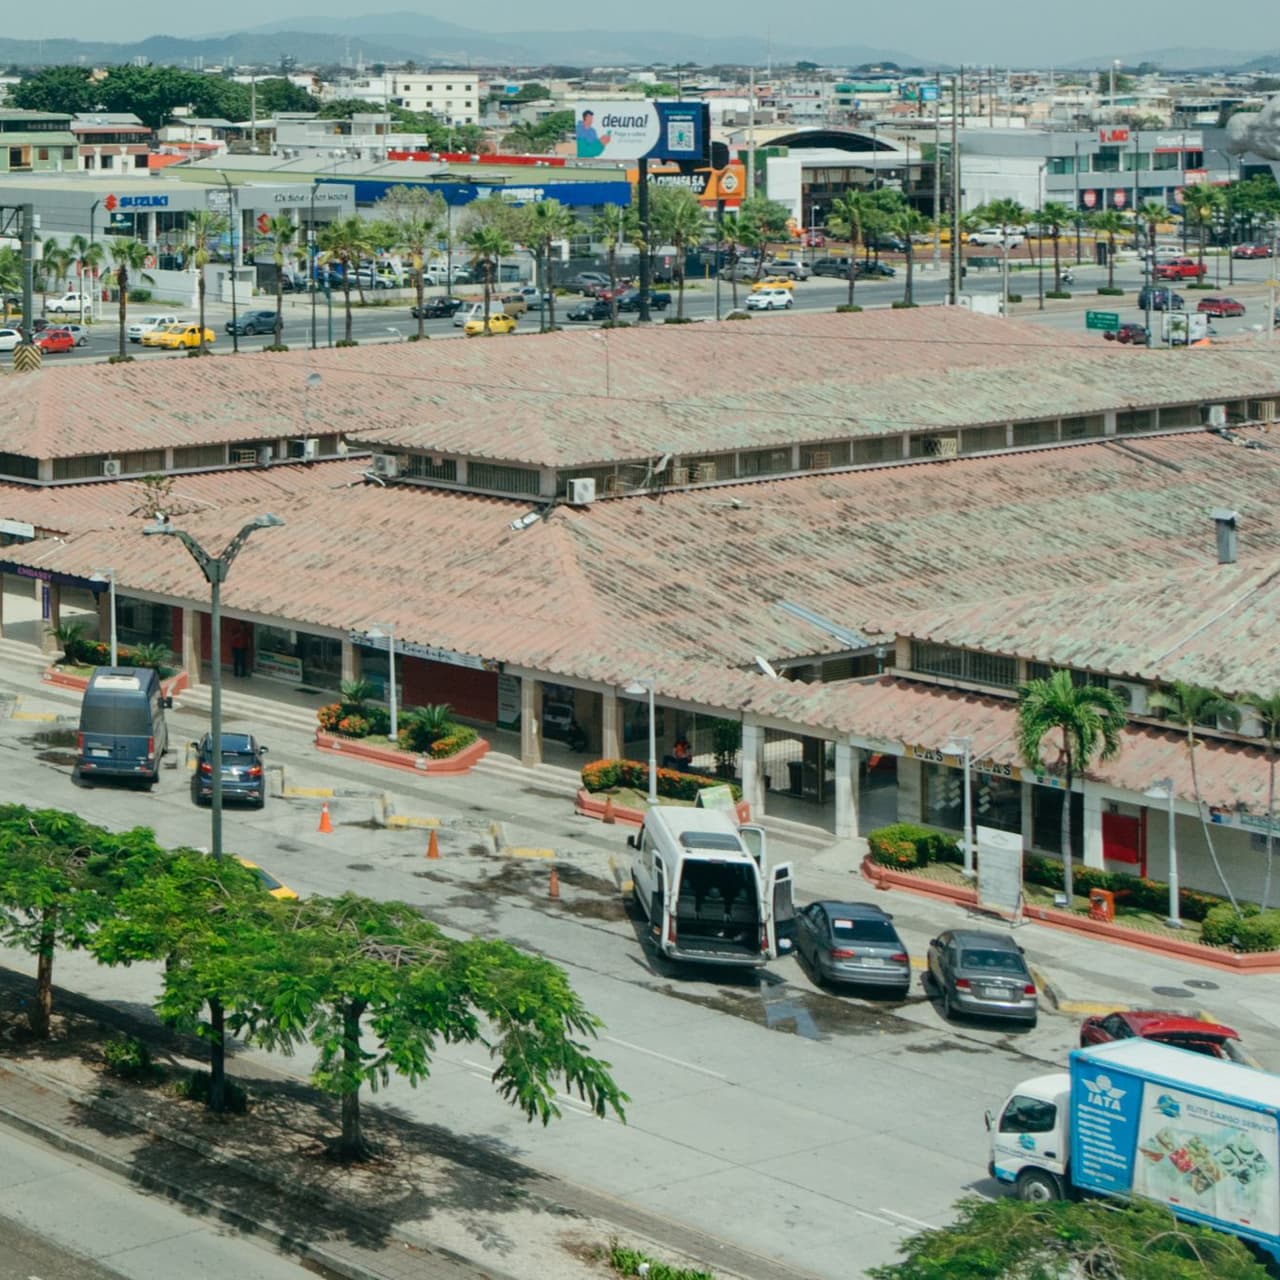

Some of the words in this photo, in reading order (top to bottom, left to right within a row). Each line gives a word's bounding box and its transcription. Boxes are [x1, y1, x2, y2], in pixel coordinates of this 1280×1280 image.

[602, 113, 648, 128] deuna!
[120, 196, 168, 207] SUZUKI
[1088, 1091, 1121, 1111] IATA
